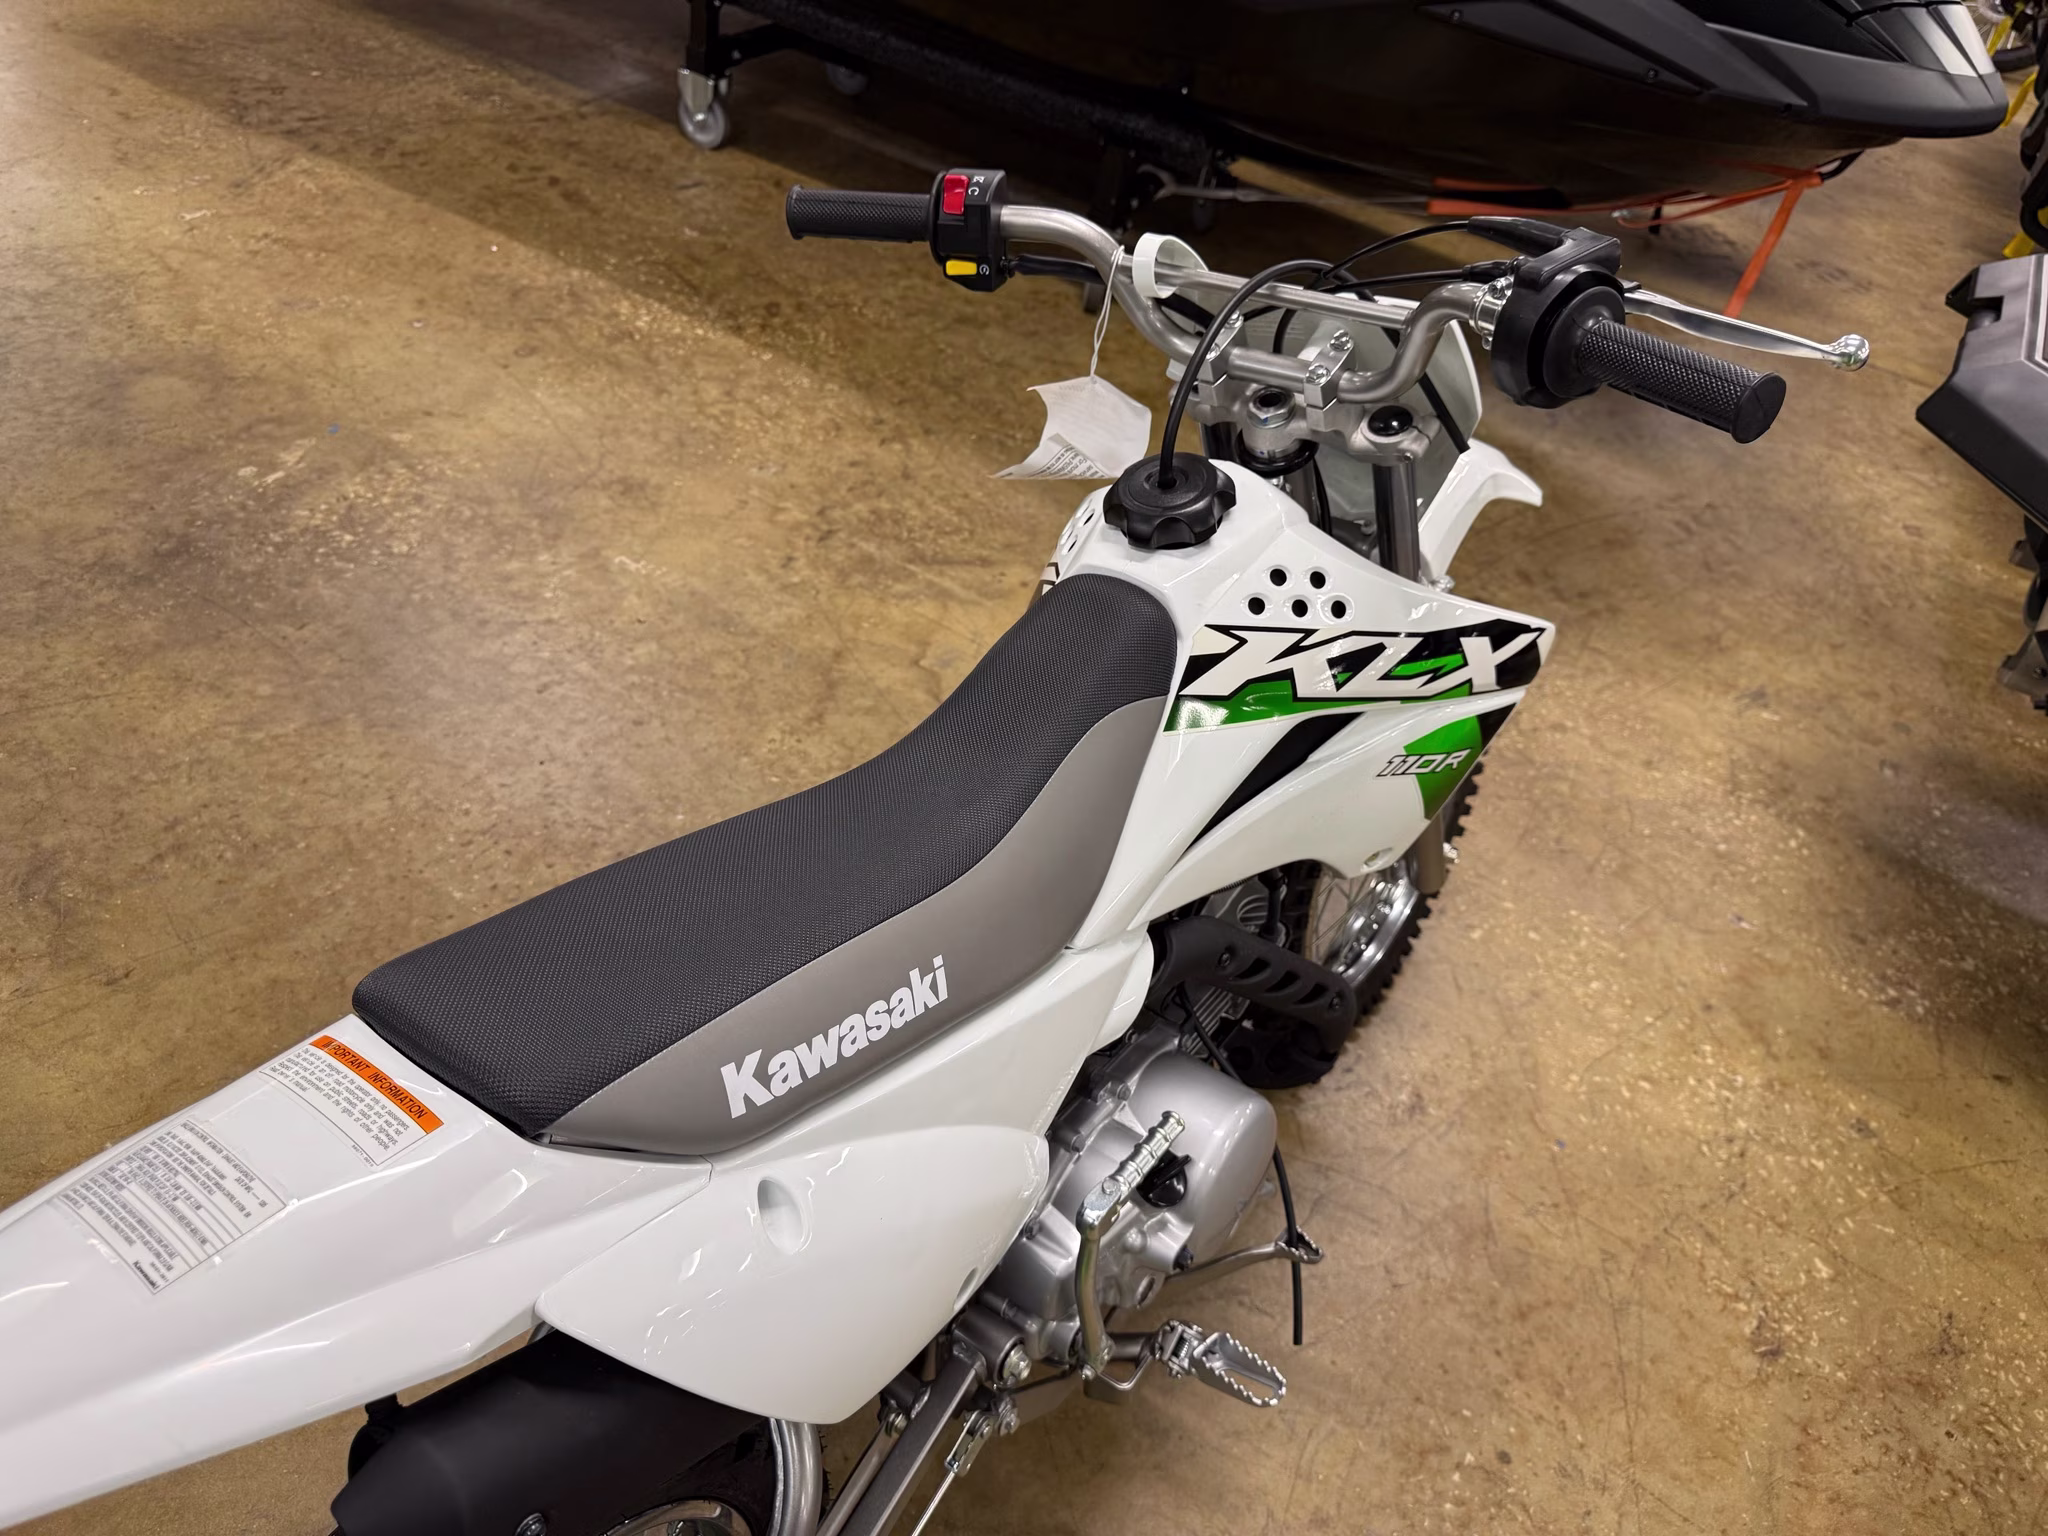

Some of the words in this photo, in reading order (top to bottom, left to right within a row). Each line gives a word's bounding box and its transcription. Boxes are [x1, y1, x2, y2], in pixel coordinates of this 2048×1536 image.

[1178, 628, 1546, 699] KLX
[1376, 748, 1472, 777] 110R
[720, 954, 949, 1119] Kawasaki
[322, 1040, 371, 1072] IMPORTANT
[367, 1071, 429, 1120] INFORMATION
[359, 1121, 374, 1133] other
